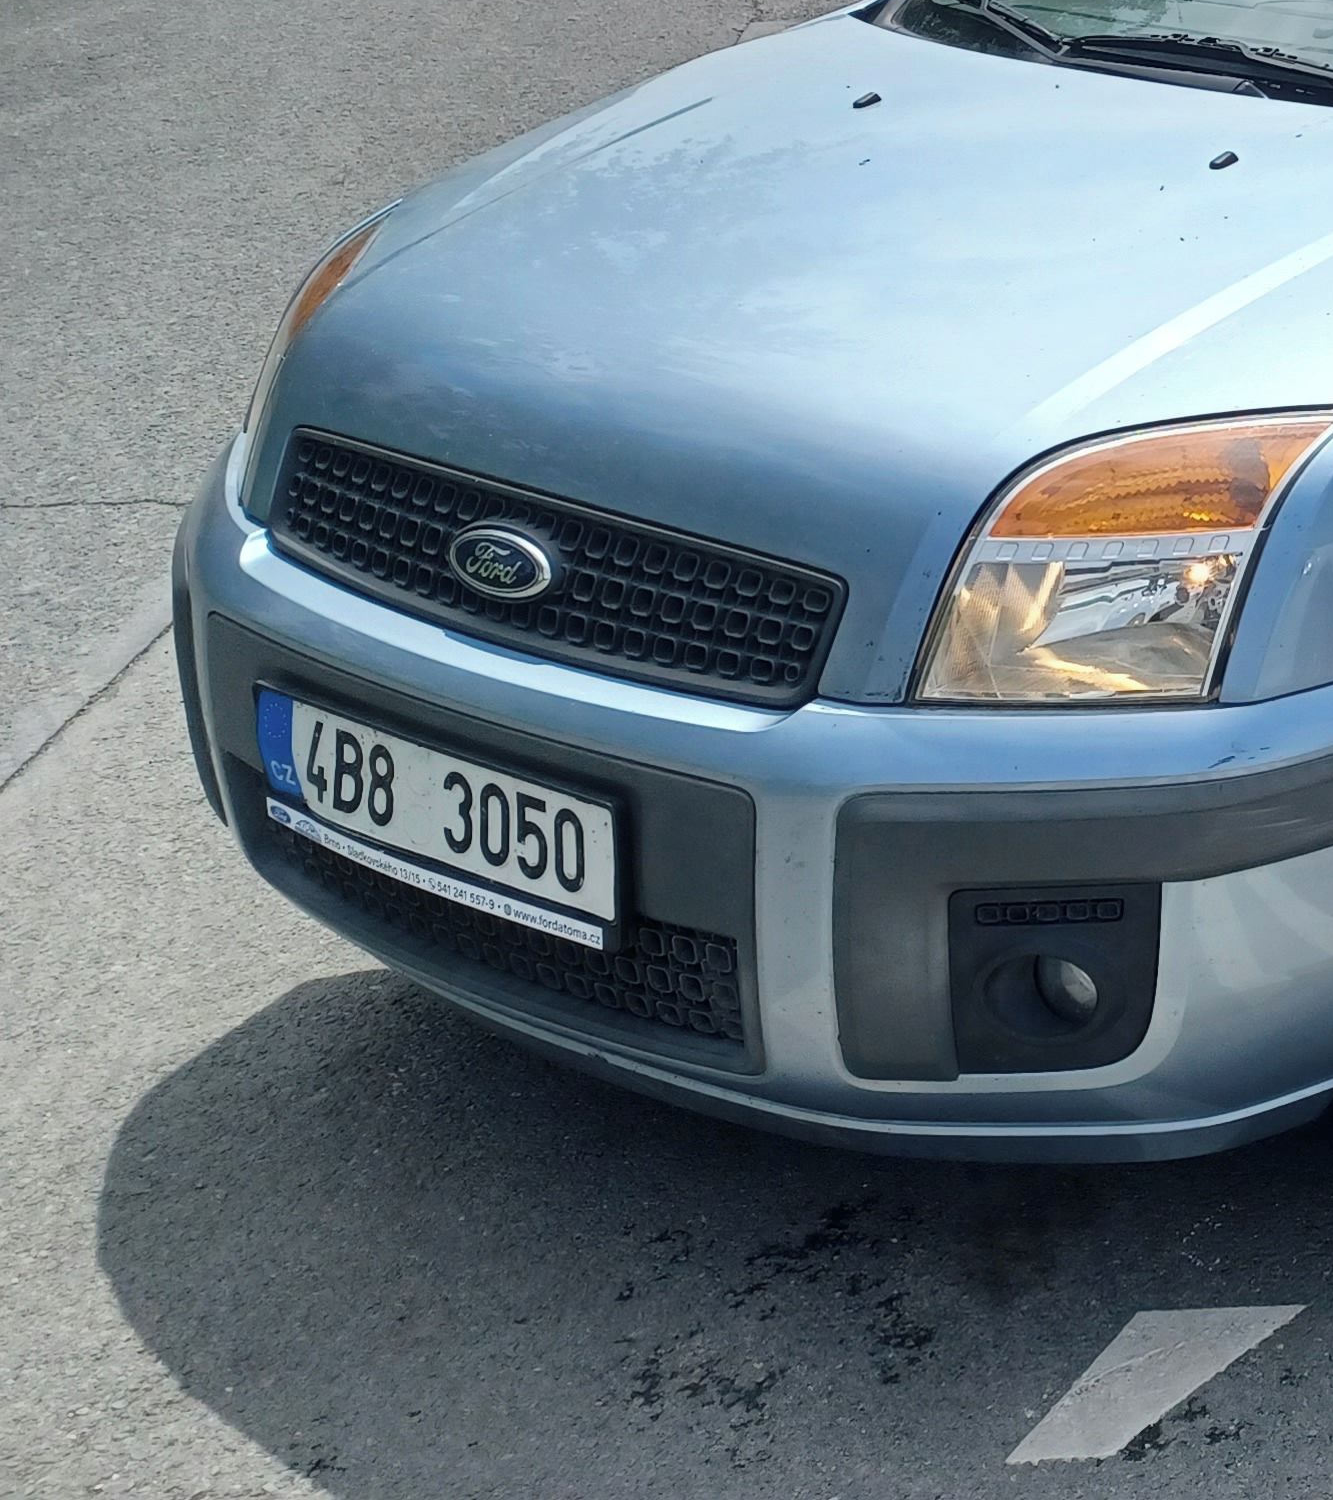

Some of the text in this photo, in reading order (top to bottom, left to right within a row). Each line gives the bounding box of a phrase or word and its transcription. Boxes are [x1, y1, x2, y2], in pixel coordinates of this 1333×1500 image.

[466, 541, 520, 585] Ford
[270, 760, 297, 786] CZ
[306, 721, 585, 893] 4B8 3050
[399, 867, 421, 885] 13/15
[437, 880, 451, 896] 541
[453, 886, 467, 901] 241
[513, 907, 601, 945] www.fordatoma.cz
